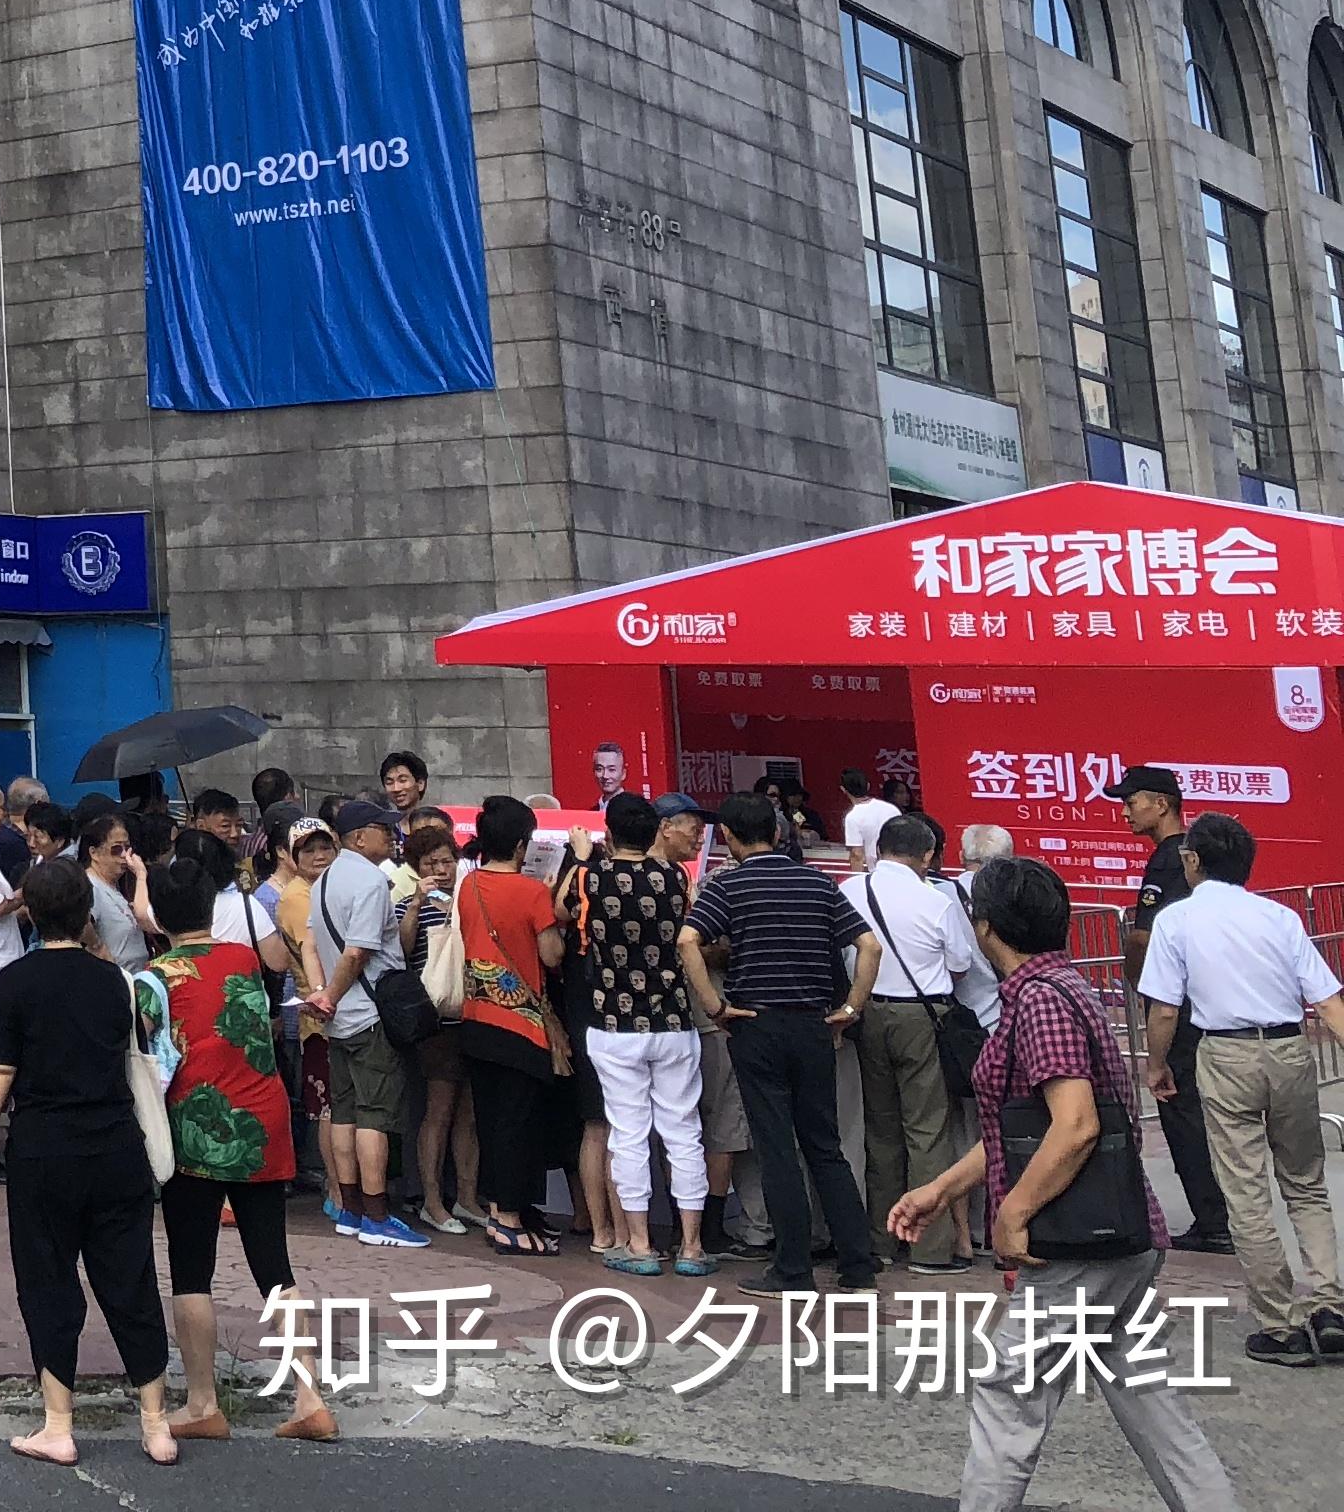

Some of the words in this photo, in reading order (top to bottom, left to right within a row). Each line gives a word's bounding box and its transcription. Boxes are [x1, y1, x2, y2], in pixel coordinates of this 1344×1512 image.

[183, 137, 409, 196] 400-820-1103
[910, 528, 1278, 598] 和家家博会
[663, 613, 725, 635] 和家
[697, 671, 763, 687] 免费取票
[812, 675, 881, 692] 免费取票
[1017, 806, 1127, 823] SIGN-I
